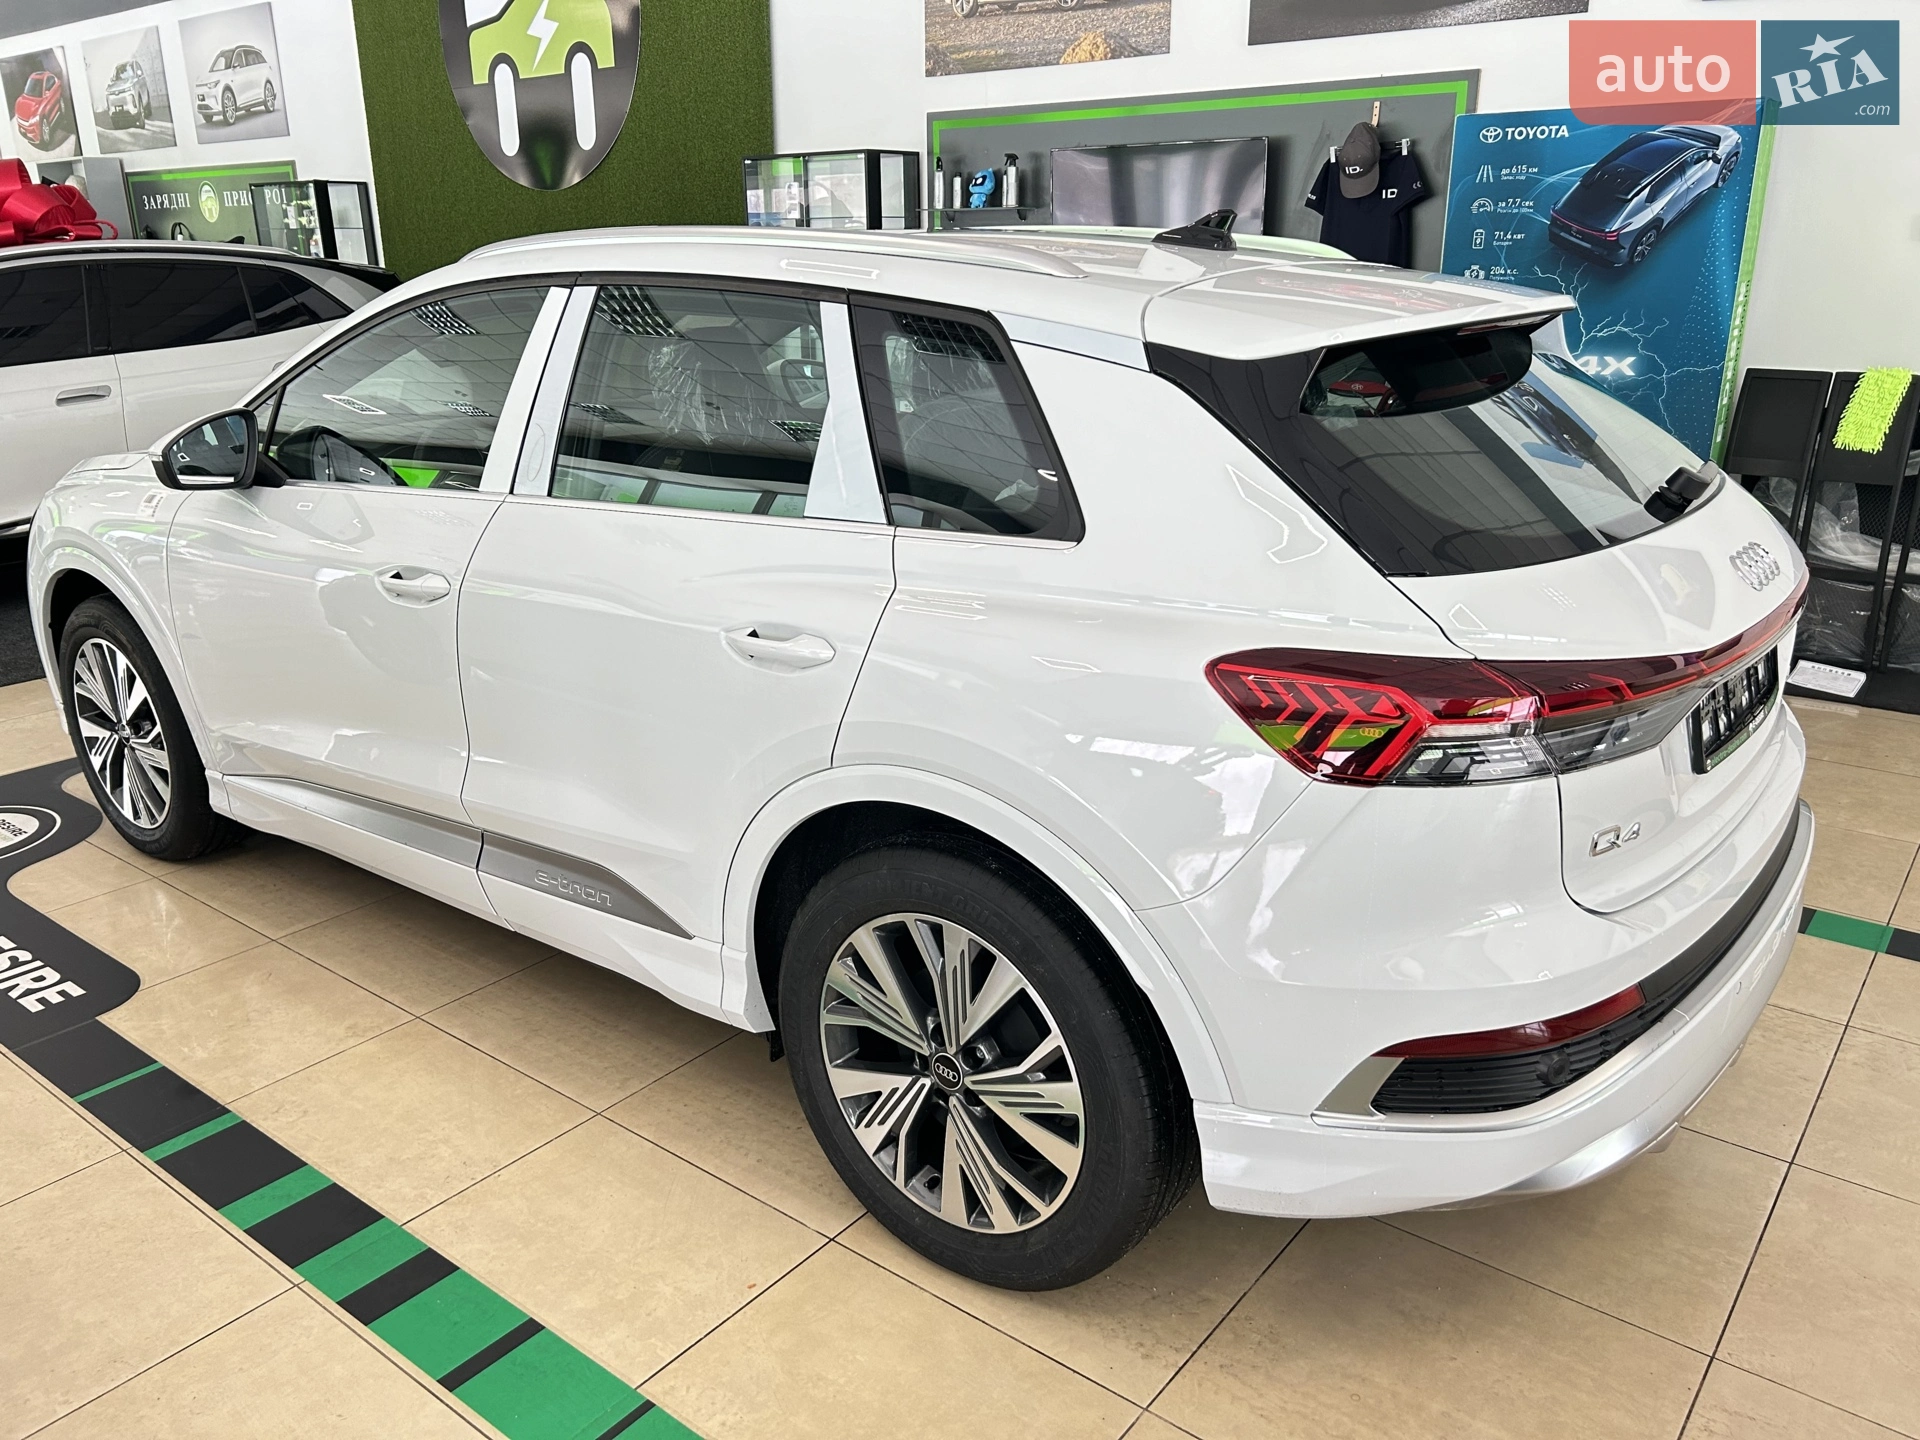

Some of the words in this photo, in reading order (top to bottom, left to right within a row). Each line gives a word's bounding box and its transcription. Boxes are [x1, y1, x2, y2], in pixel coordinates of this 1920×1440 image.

[1505, 124, 1569, 140] TOYOTA
[1511, 164, 1527, 174] 615
[142, 192, 191, 210] ЗАРЯДНІ
[1507, 198, 1521, 208] 7,7
[1494, 231, 1512, 240] 71,4
[1490, 266, 1505, 275] 204
[1589, 821, 1641, 858] Q4
[534, 870, 613, 907] e-tron
